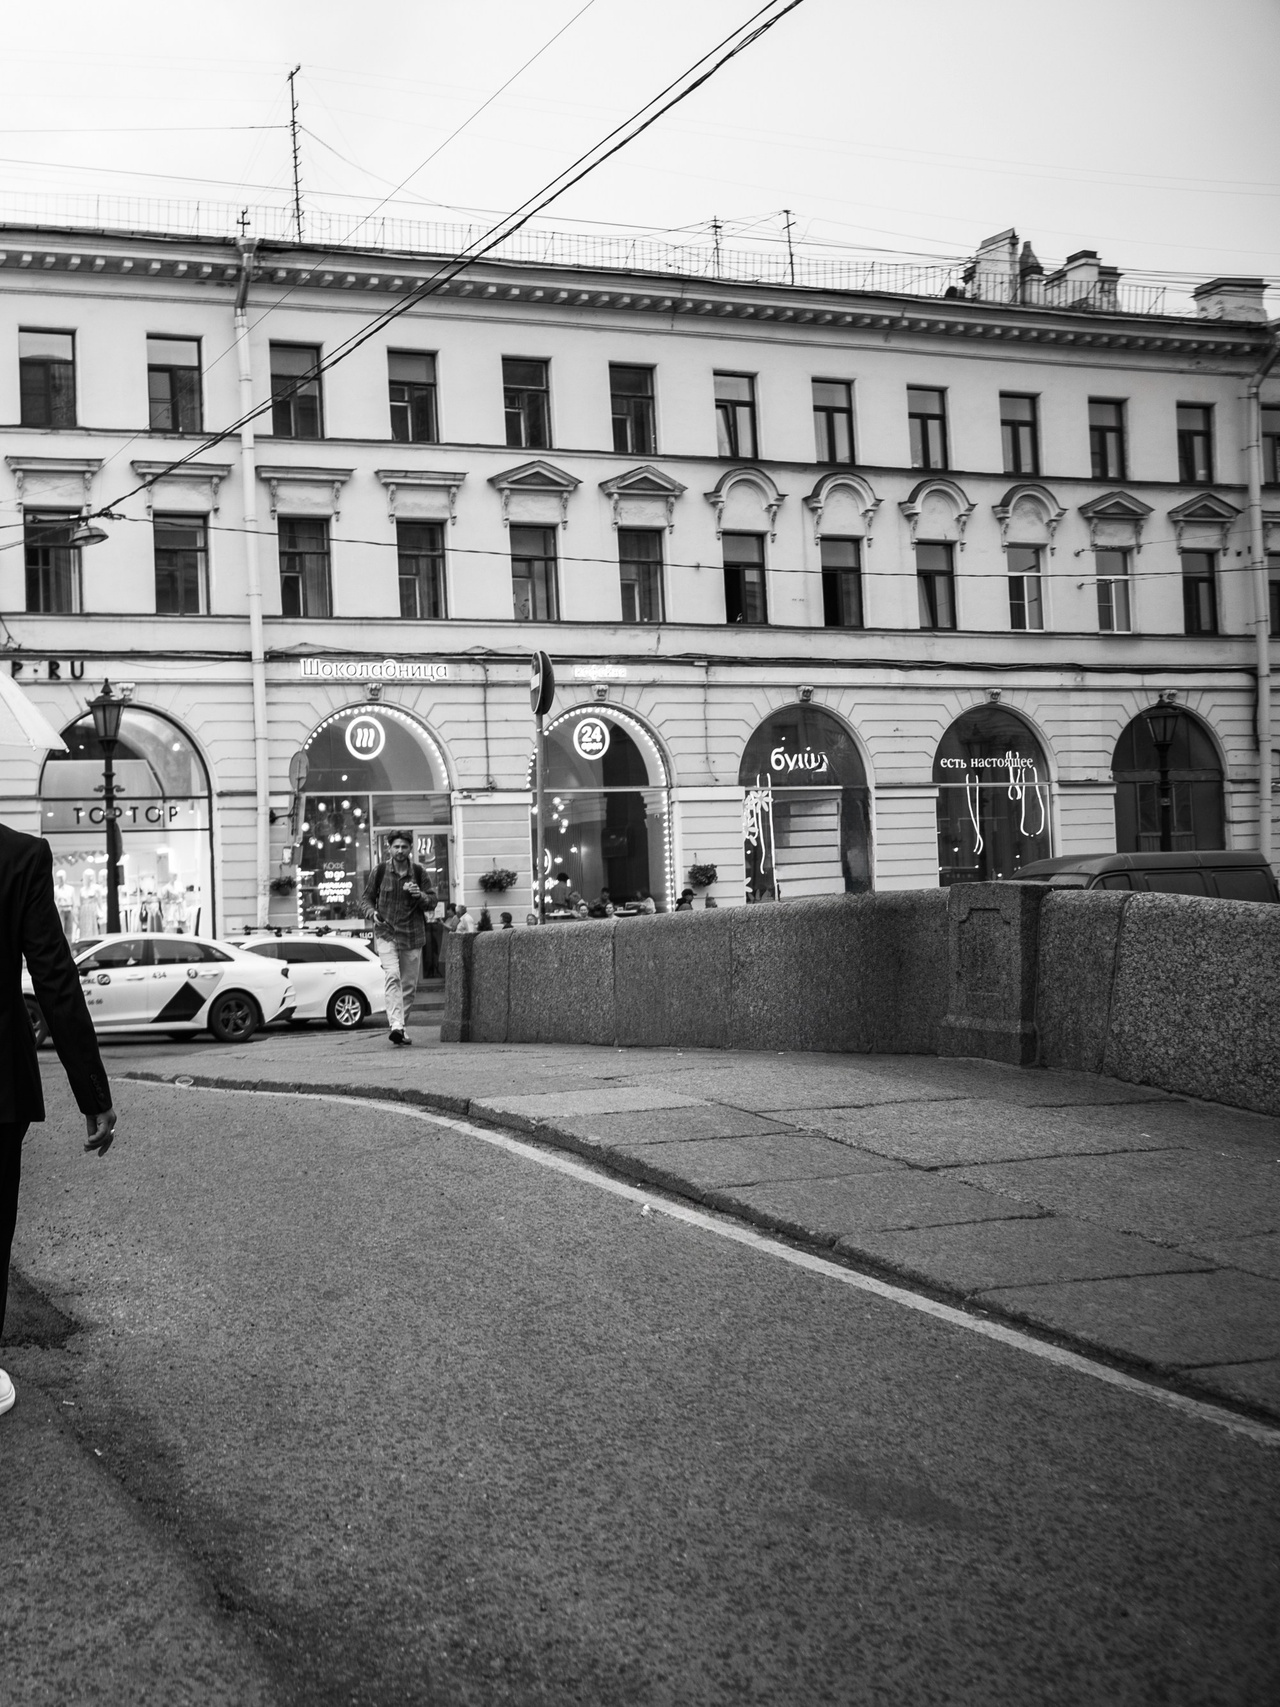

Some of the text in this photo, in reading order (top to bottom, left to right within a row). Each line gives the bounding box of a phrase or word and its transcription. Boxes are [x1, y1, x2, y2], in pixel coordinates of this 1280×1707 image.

[300, 658, 448, 682] Шоколадница
[581, 725, 602, 742] 24
[940, 757, 1034, 770] есть настоящее
[73, 805, 179, 825] TOPTOP
